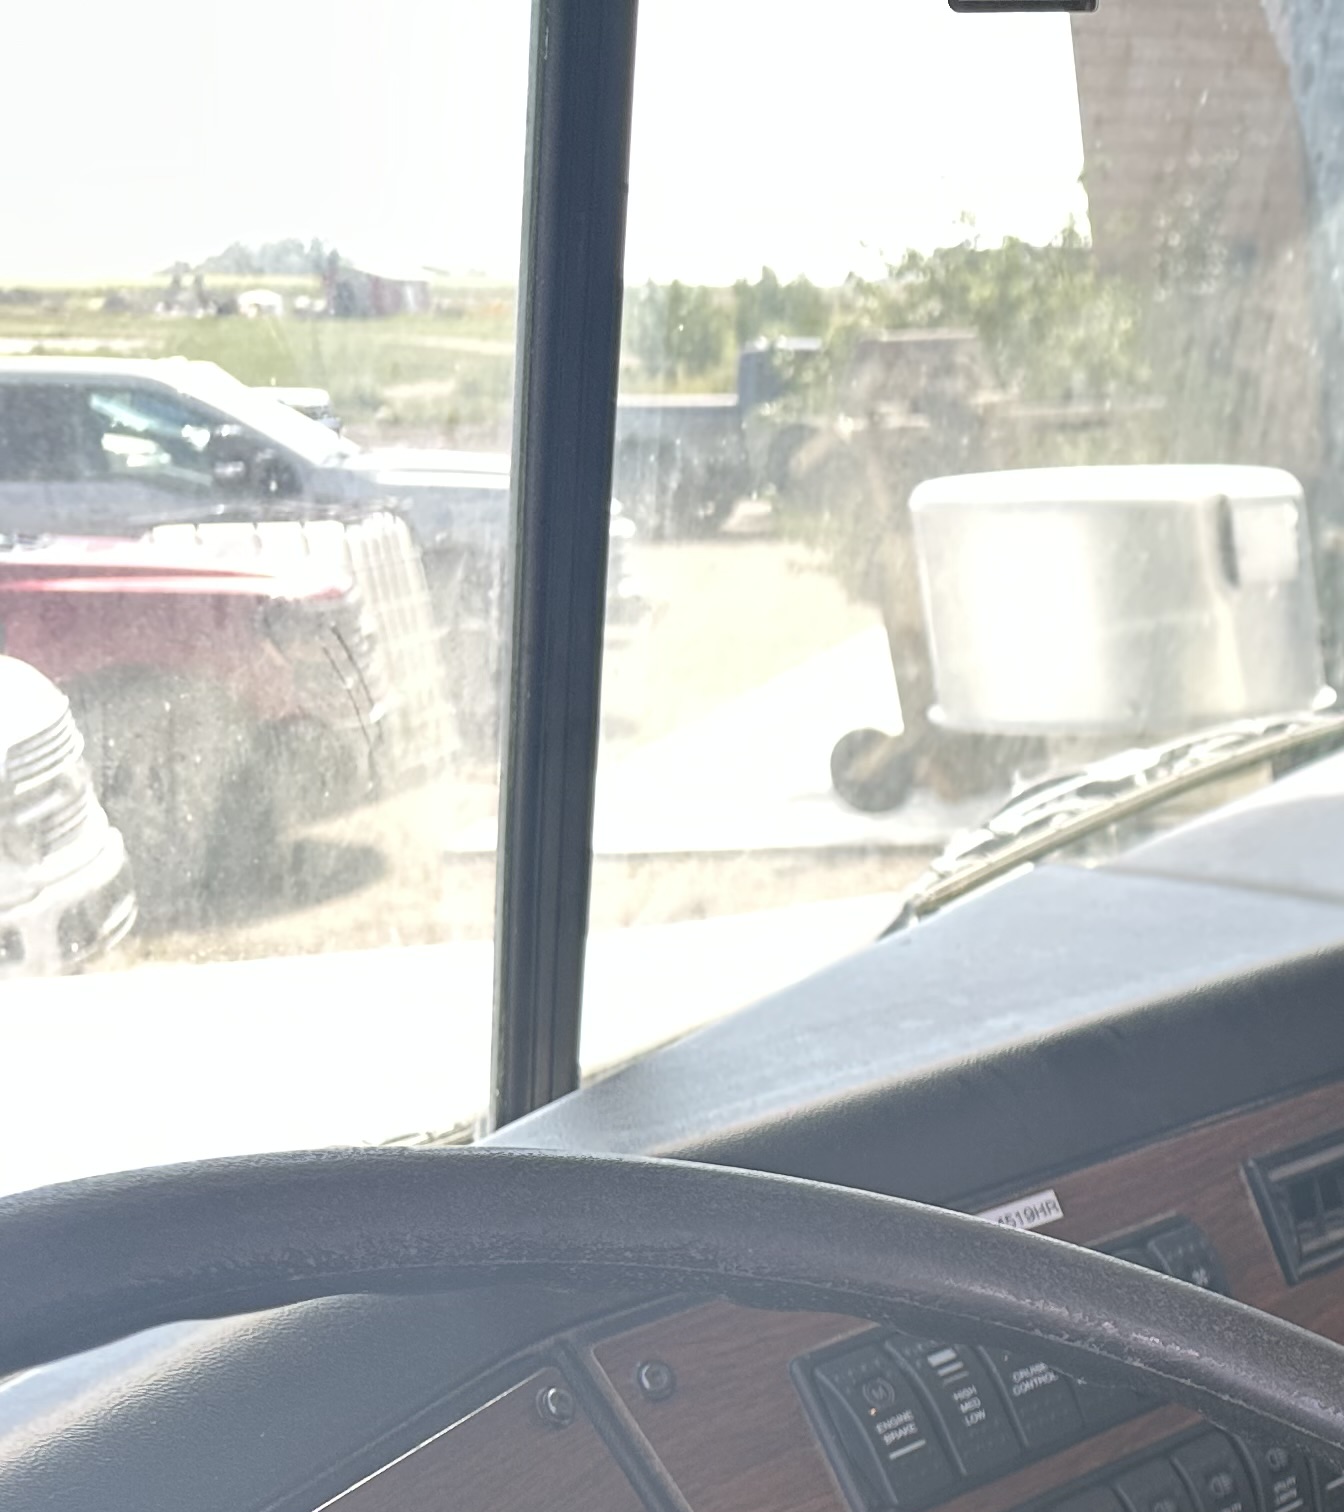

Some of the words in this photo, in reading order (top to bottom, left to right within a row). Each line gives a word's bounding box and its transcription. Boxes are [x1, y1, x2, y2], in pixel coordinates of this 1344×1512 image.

[953, 1384, 978, 1402] HIGH
[1012, 1372, 1059, 1397] CONTROL
[876, 1409, 914, 1434] ENGINE
[964, 1409, 986, 1427] LOW
[883, 1423, 918, 1446] BRAKE
